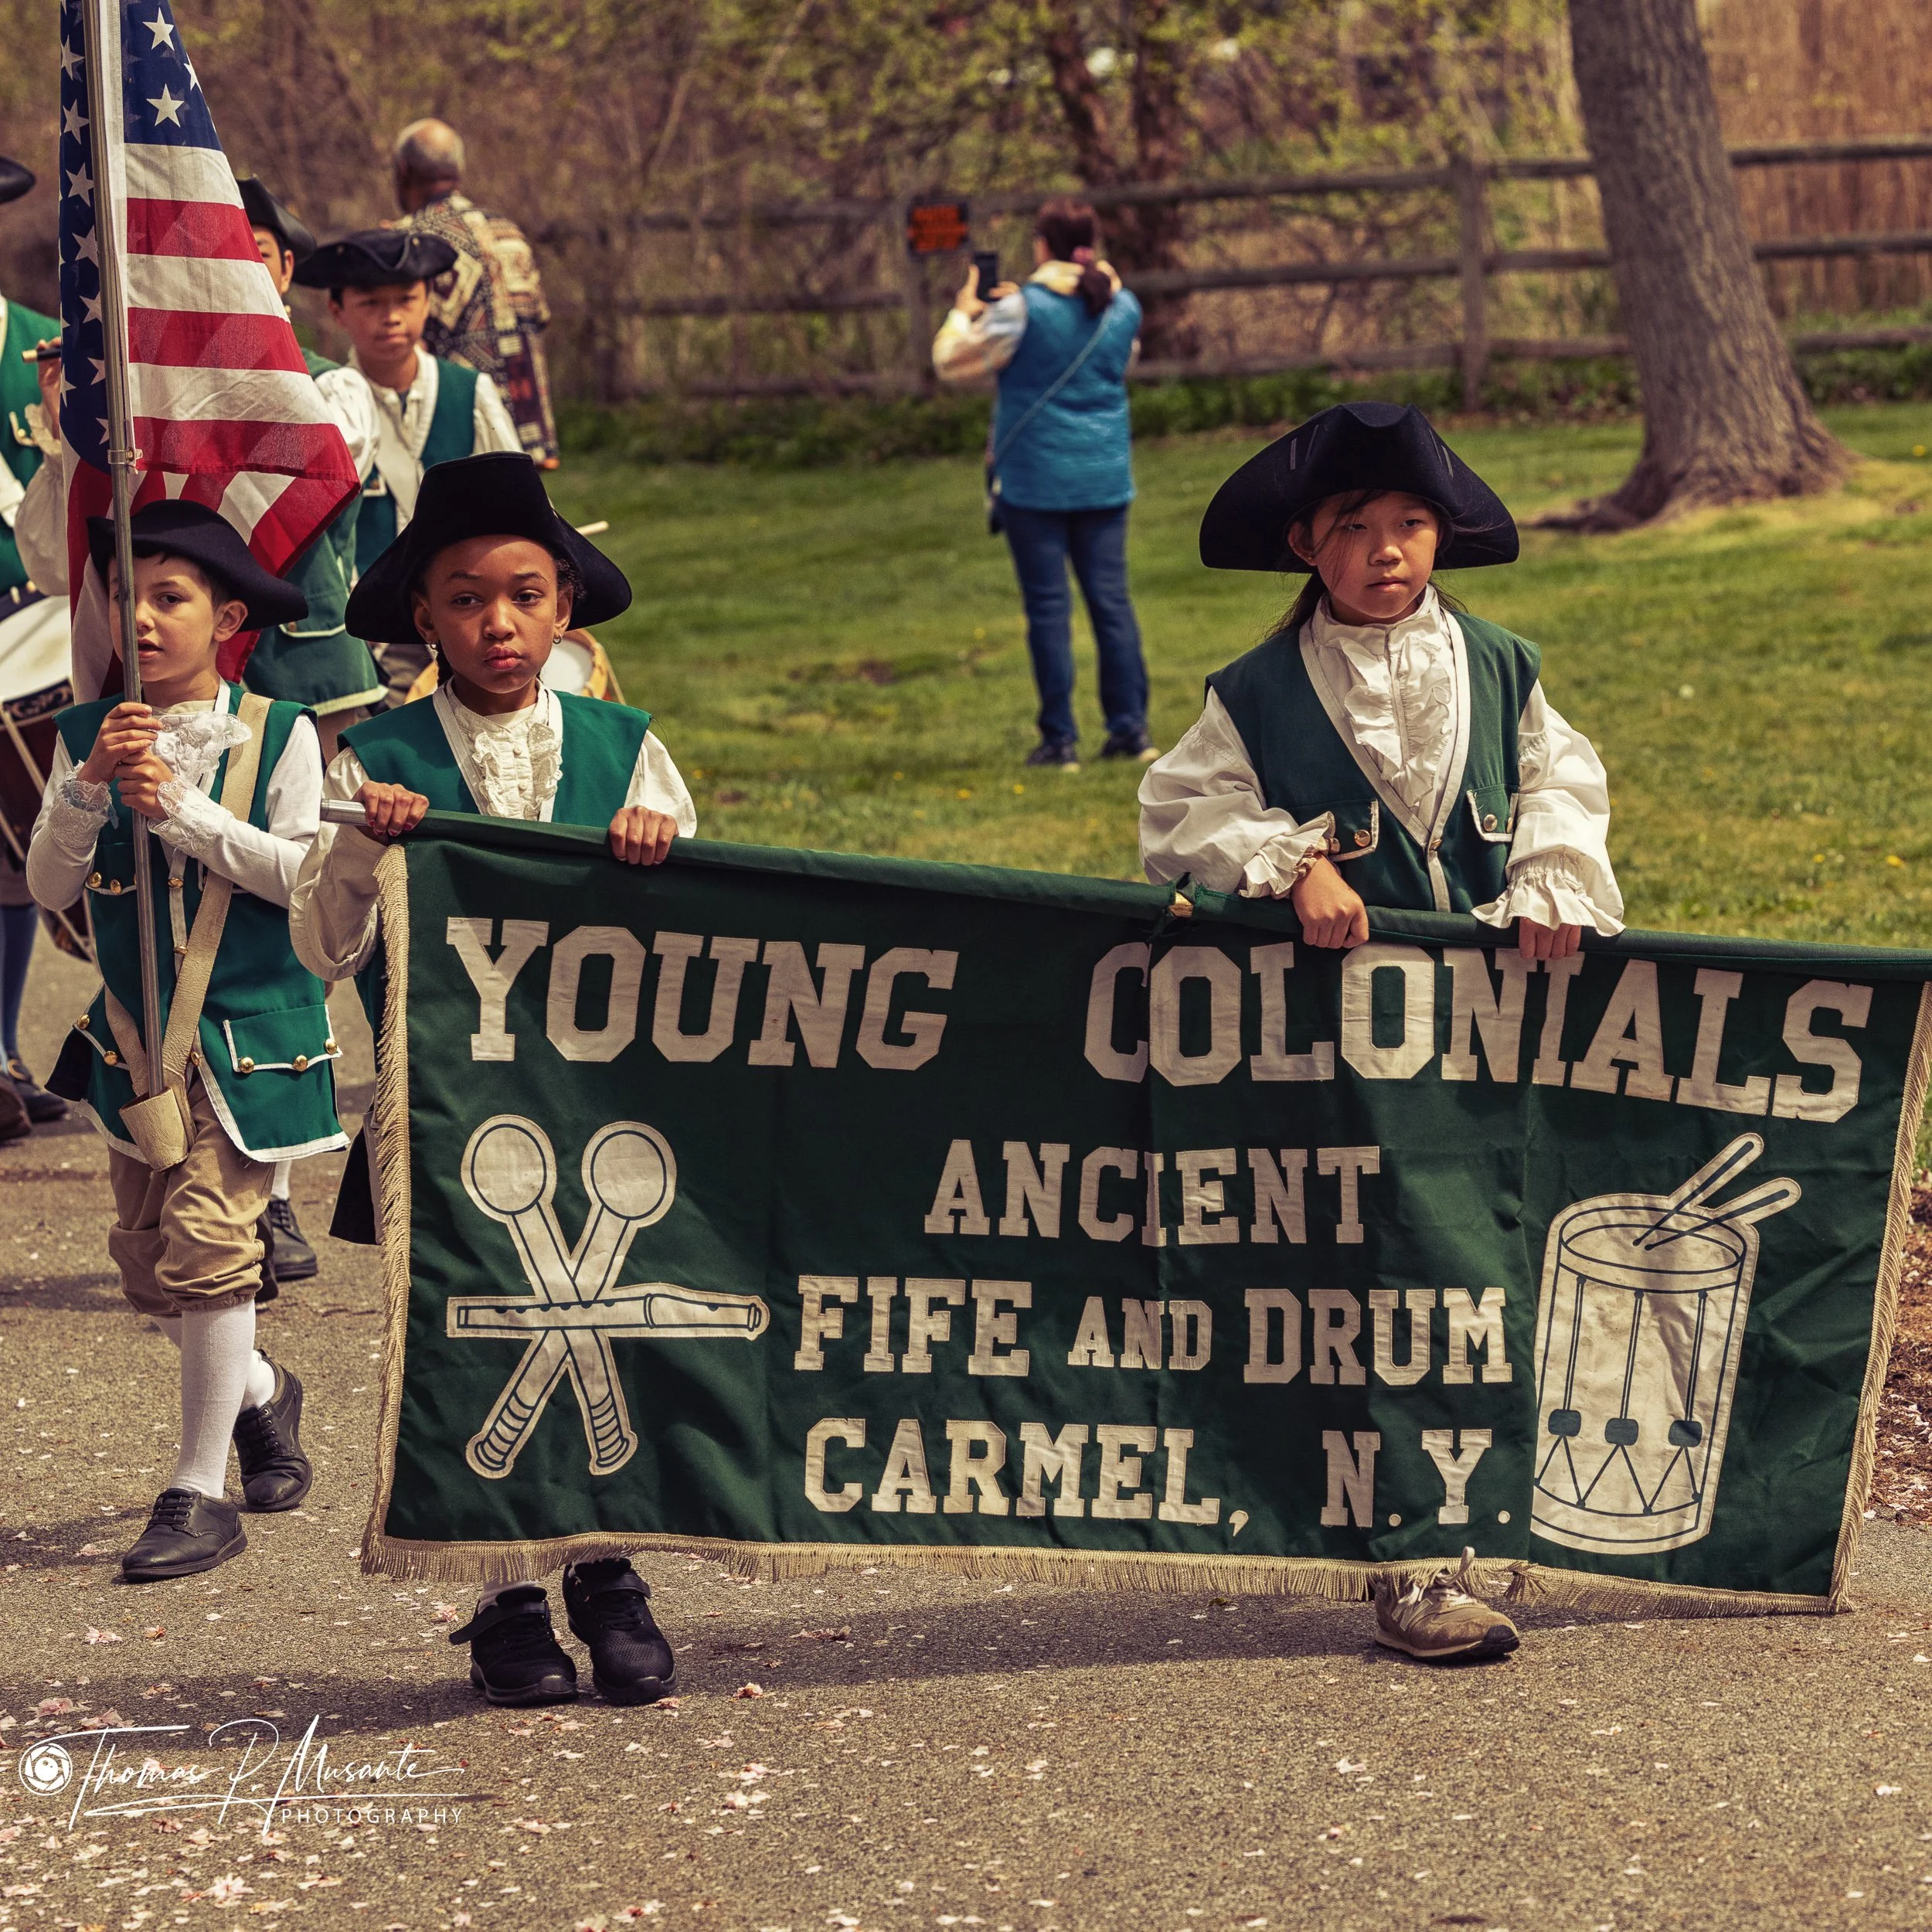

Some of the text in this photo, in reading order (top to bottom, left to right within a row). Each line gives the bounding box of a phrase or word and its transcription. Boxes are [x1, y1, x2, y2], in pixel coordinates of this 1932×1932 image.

[445, 916, 1873, 1124] YOUNG COLONIALS
[923, 1139, 1380, 1247] ANCIENT
[794, 1276, 1512, 1386] FIFE AND DRUM
[804, 1417, 1249, 1538] CARMEL,
